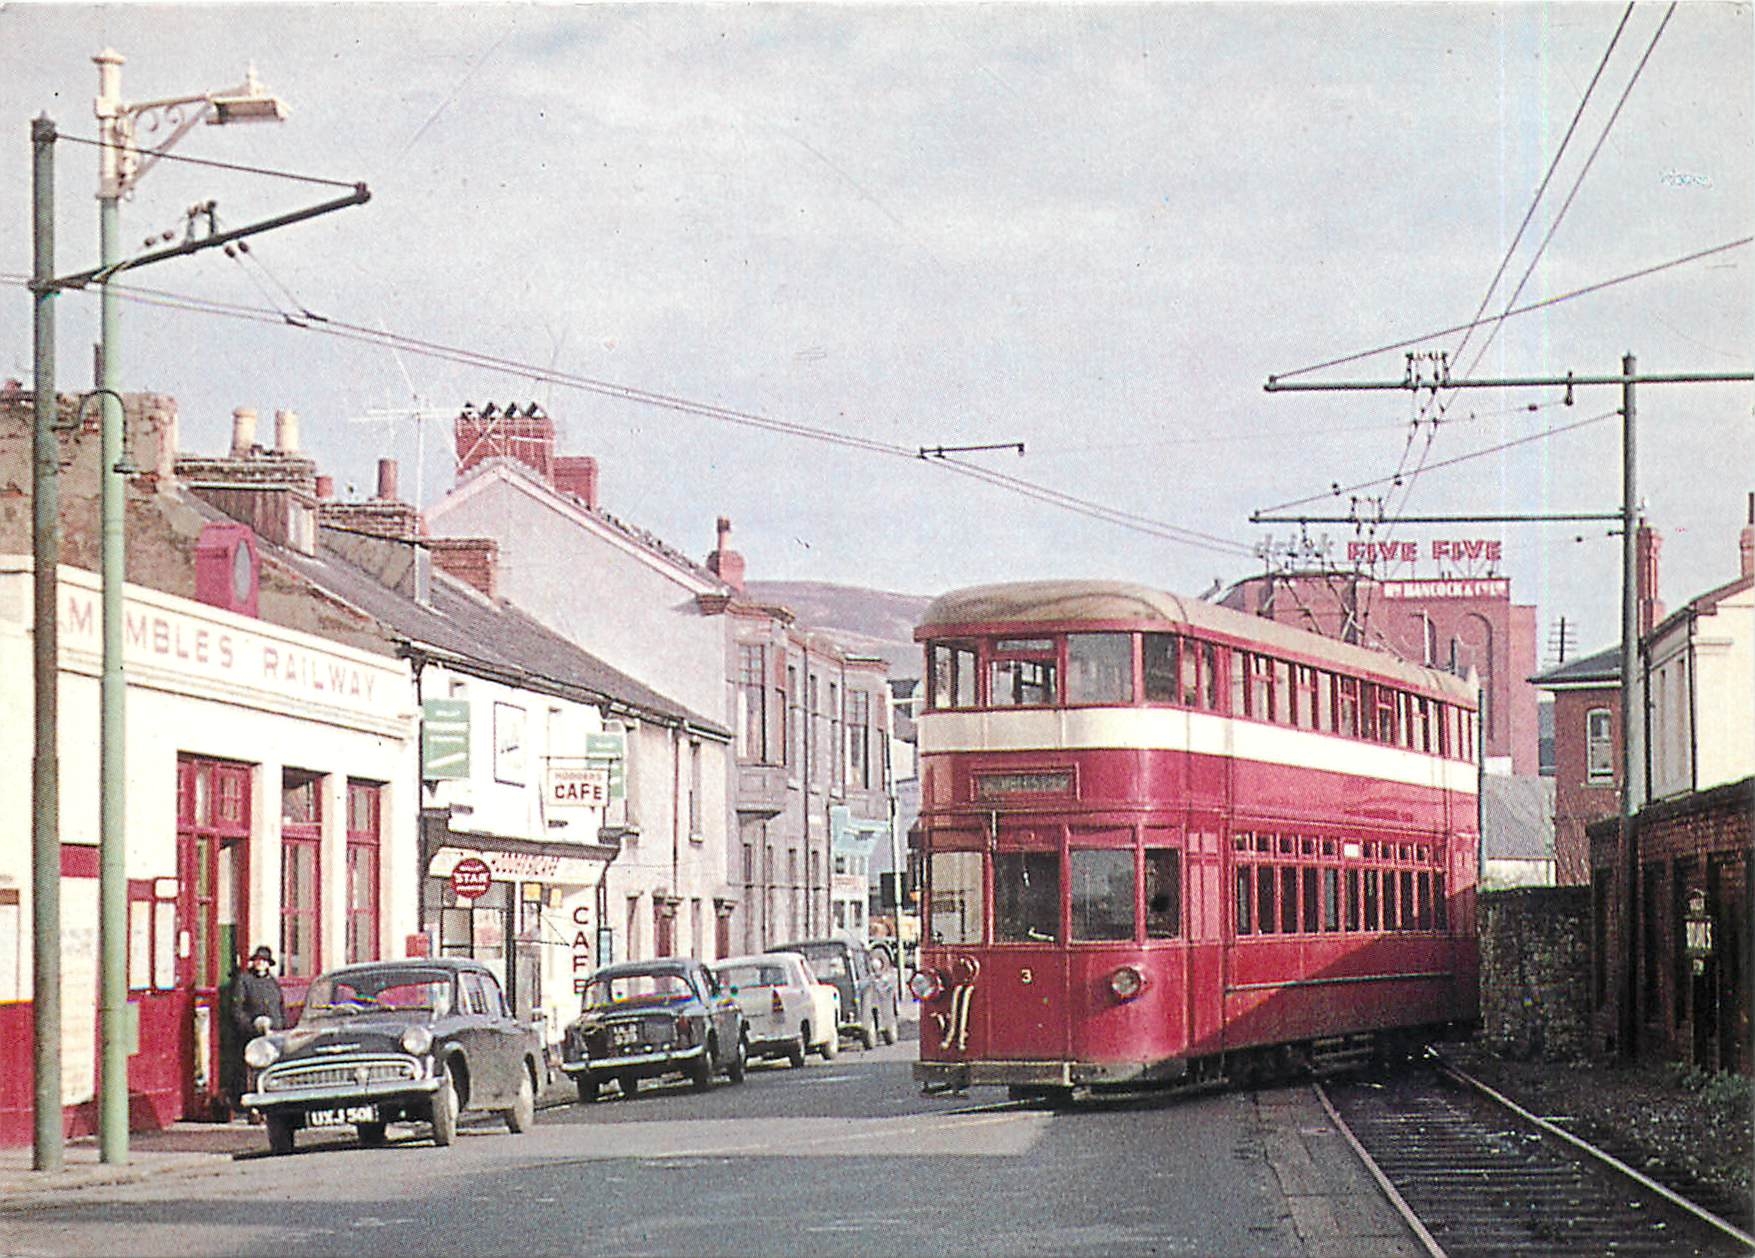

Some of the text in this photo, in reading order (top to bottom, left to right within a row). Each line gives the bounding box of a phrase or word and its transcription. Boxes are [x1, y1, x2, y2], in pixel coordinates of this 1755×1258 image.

[1347, 539, 1502, 564] FIVE FIVE
[68, 596, 377, 700] MMBLES RAILWAY
[555, 783, 602, 800] CAFE
[454, 872, 489, 884] STAR
[573, 906, 589, 994] CAFE
[1021, 968, 1032, 984] 3
